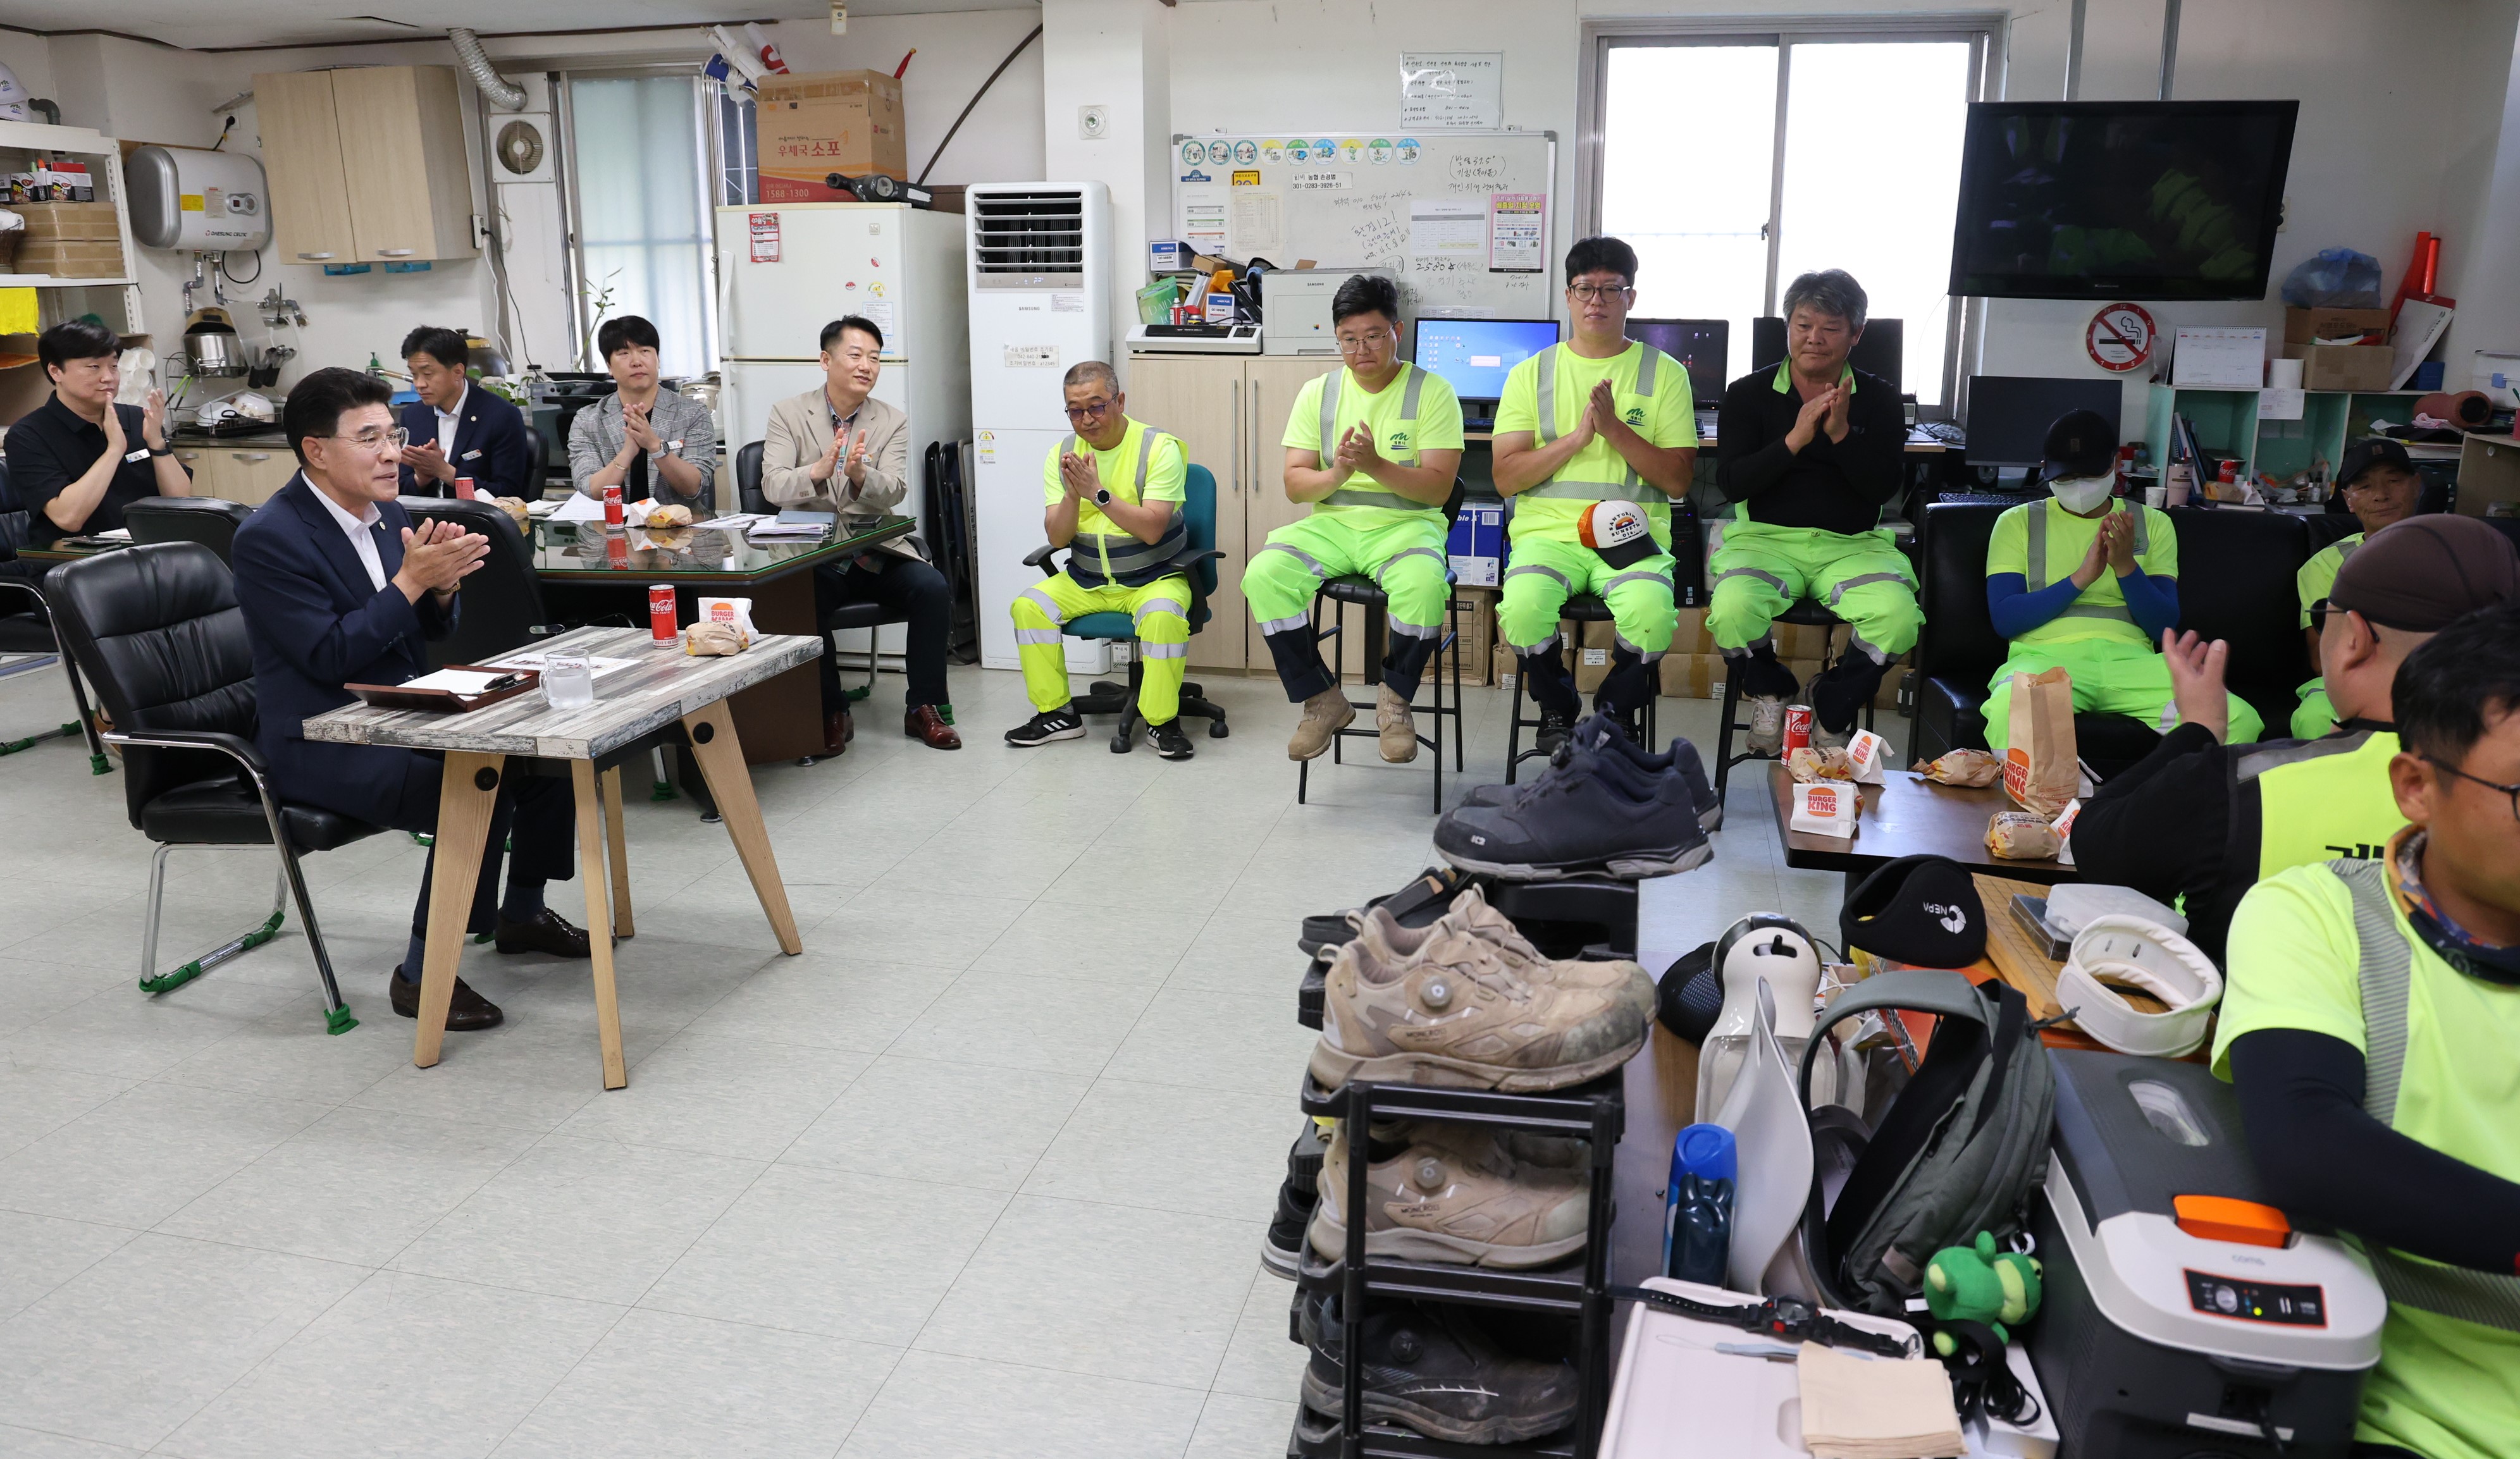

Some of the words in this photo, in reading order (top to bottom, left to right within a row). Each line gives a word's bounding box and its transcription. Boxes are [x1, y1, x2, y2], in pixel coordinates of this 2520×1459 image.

[778, 144, 808, 157] 우체국
[811, 141, 841, 157] 소포
[766, 188, 809, 198] 1588-1300
[1611, 524, 1637, 537] SUNSET
[1857, 741, 1870, 752] BURGER
[1853, 748, 1868, 761] KING
[2004, 768, 2026, 795] KING
[1808, 795, 1837, 803] BURGER
[1807, 801, 1837, 812] KING
[1923, 901, 1948, 916] NEPA
